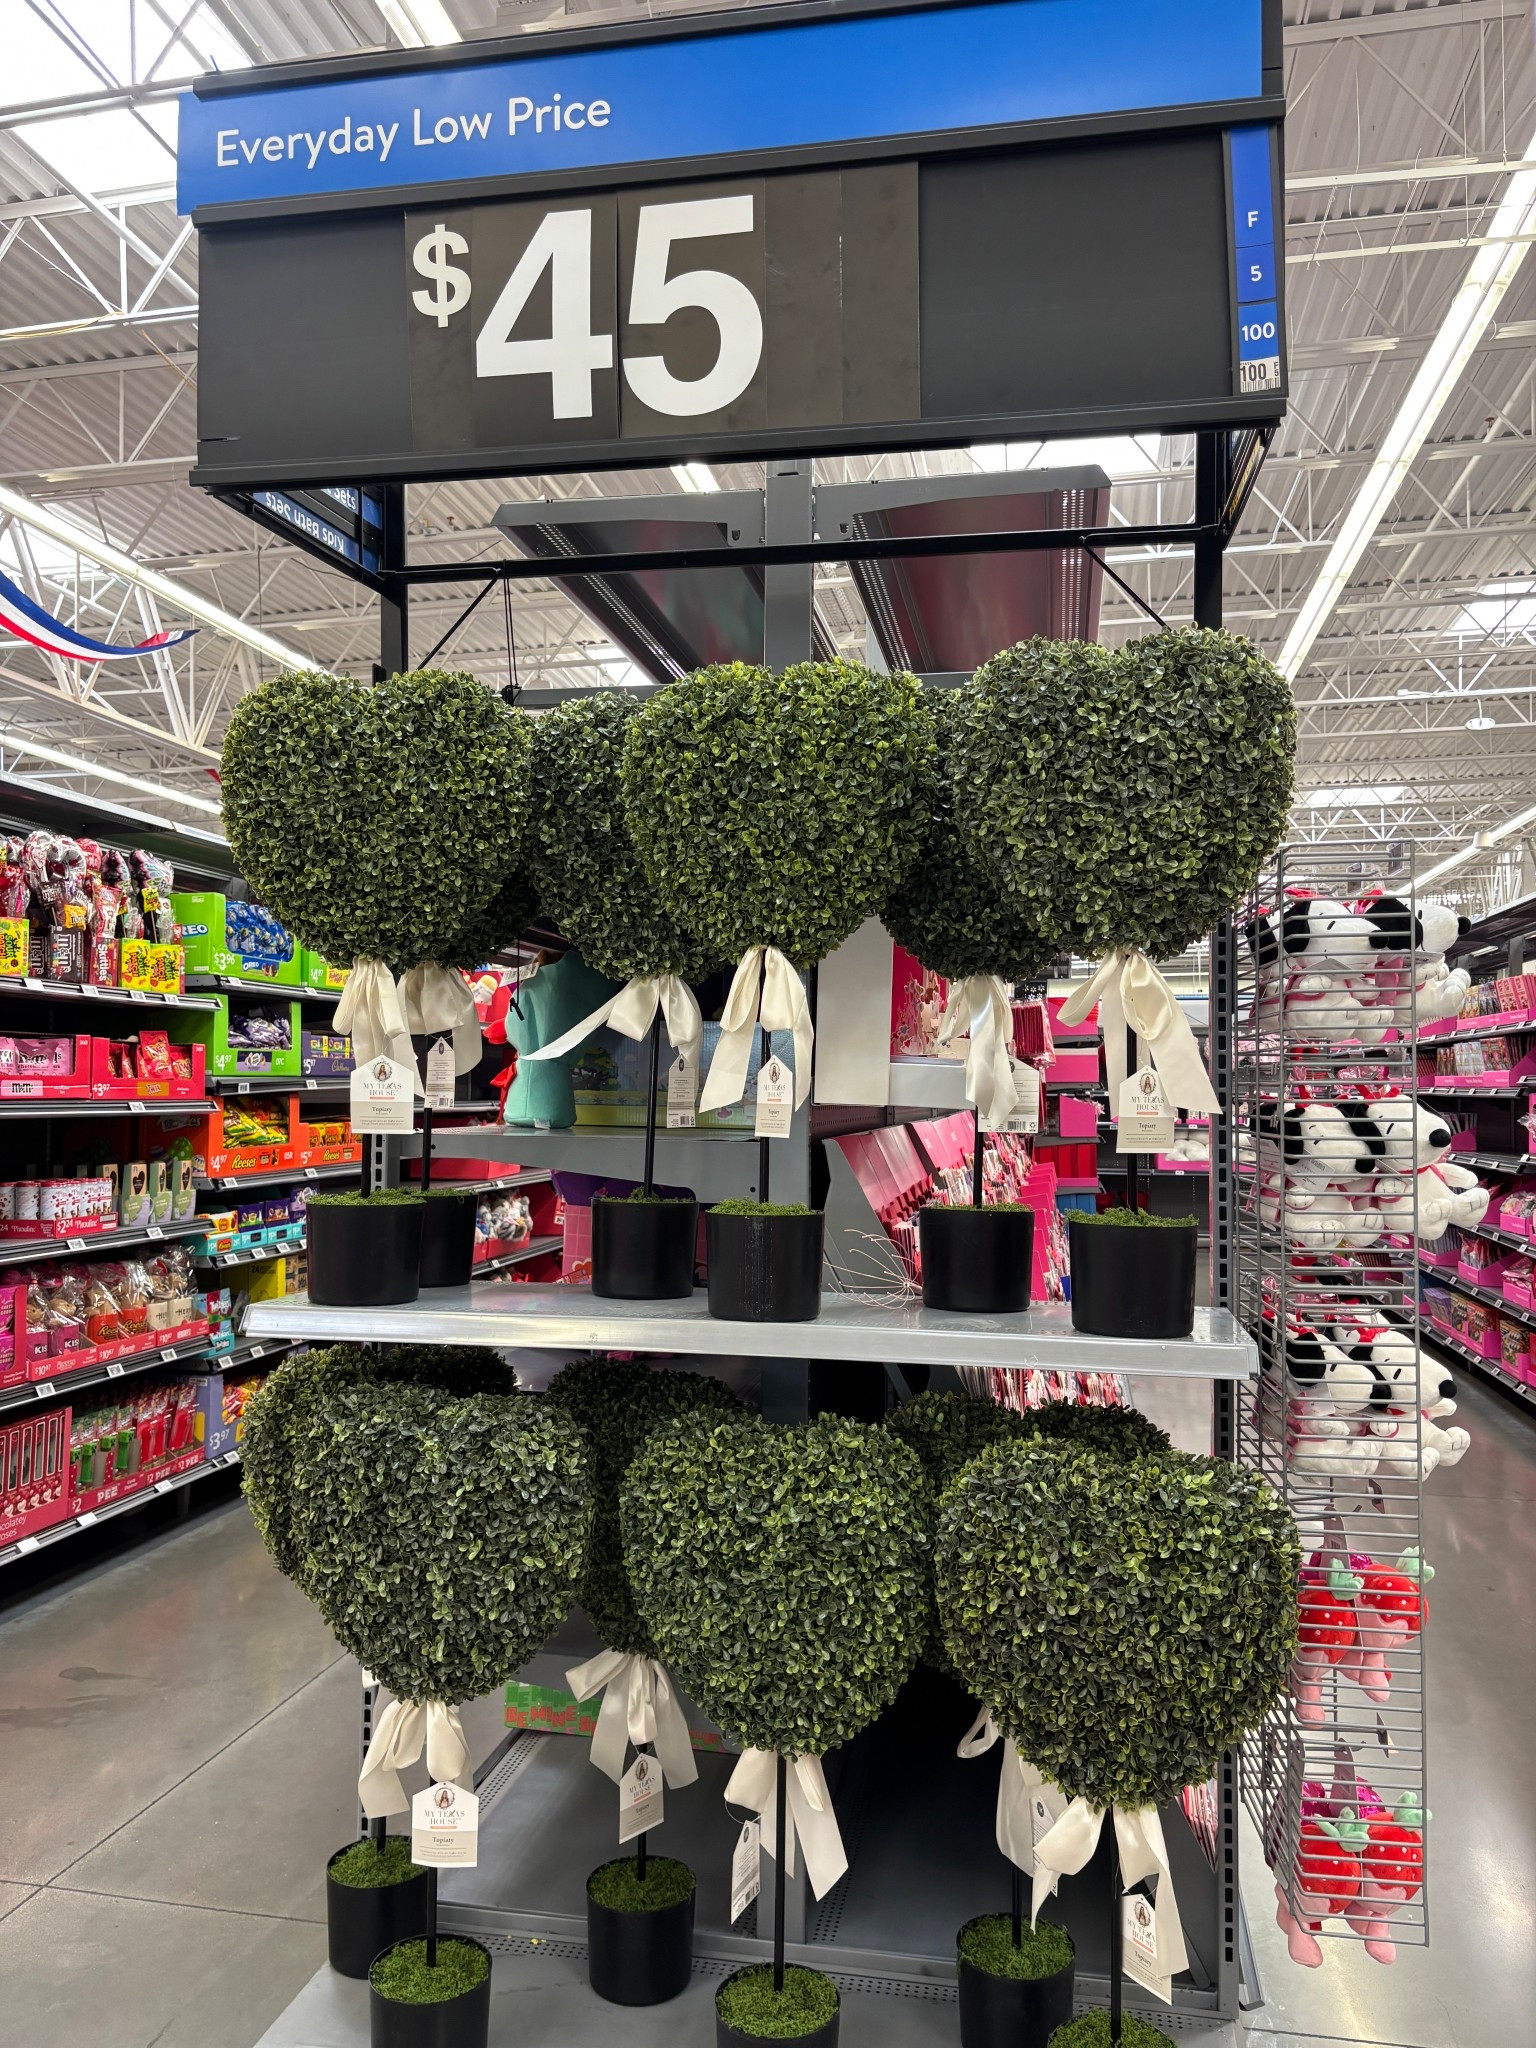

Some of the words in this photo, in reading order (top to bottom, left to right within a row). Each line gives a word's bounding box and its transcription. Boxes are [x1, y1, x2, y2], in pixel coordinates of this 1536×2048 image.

[217, 116, 399, 168] Everyday
[413, 108, 492, 146] Low
[508, 93, 611, 136] Price
[1248, 211, 1259, 228] F
[1251, 265, 1262, 282] 5
[412, 195, 763, 419] $45
[1242, 321, 1275, 341] 100
[1240, 363, 1266, 381] 100
[181, 924, 208, 936] REO
[98, 943, 110, 982] Skittles
[376, 1081, 402, 1089] TEXAS
[371, 1106, 393, 1114] Topiary
[231, 1154, 257, 1170] Reese's
[186, 1455, 199, 1467] PEZ
[155, 1468, 170, 1480] PEZ
[97, 1485, 118, 1503] PEZ
[0, 1515, 27, 1531] colatey
[506, 1706, 528, 1727] BE
[530, 1705, 577, 1727] MINE
[438, 1810, 465, 1818] TEXAS
[1138, 1926, 1155, 1942] TEXA
